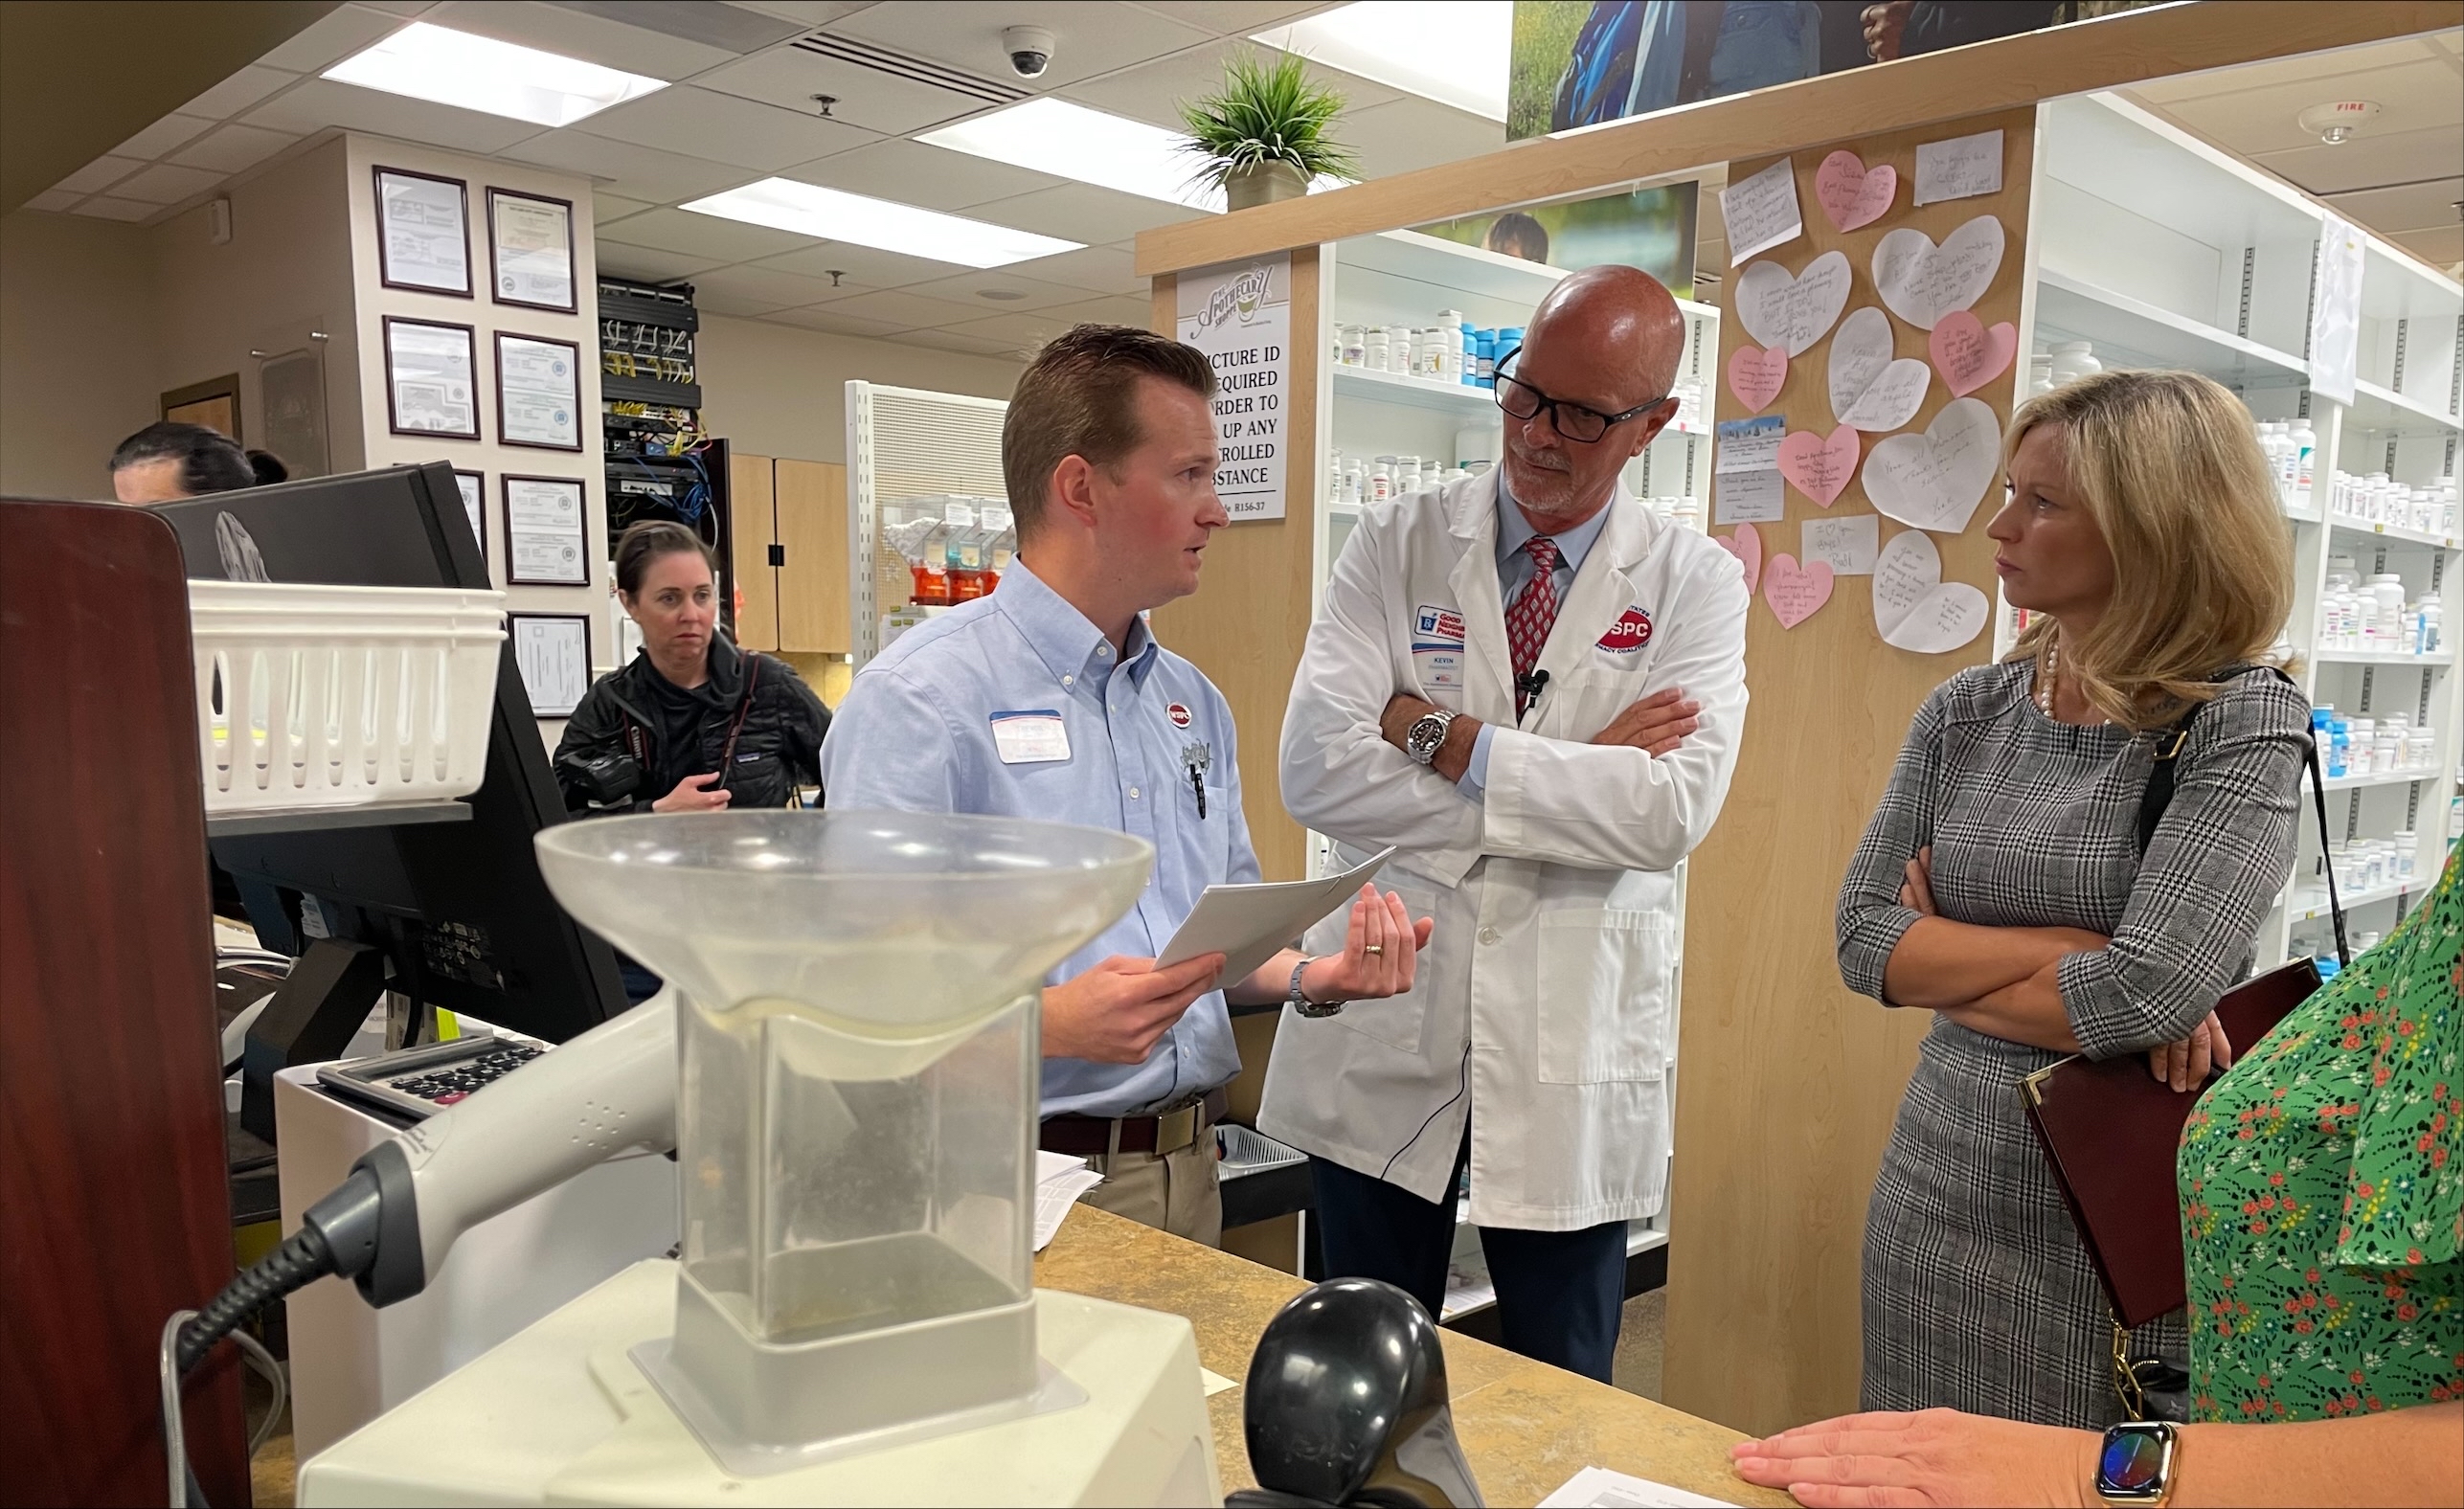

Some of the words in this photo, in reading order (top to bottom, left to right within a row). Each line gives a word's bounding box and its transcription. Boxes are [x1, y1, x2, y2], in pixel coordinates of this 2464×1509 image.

[2337, 103, 2364, 112] FIRE
[1214, 304, 1236, 327] SHOPPE
[1207, 349, 1258, 369] ICTURE
[1264, 346, 1280, 362] ID
[1216, 371, 1277, 394] QUIRED
[1211, 397, 1254, 416] RDER
[1259, 394, 1278, 411] TO
[1224, 422, 1243, 439] UP
[1247, 418, 1277, 436] ANY
[1219, 443, 1275, 462] ROLLED
[1628, 604, 1651, 618] TATES
[1436, 627, 1465, 639] PHARMA
[1611, 621, 1649, 638] SPC
